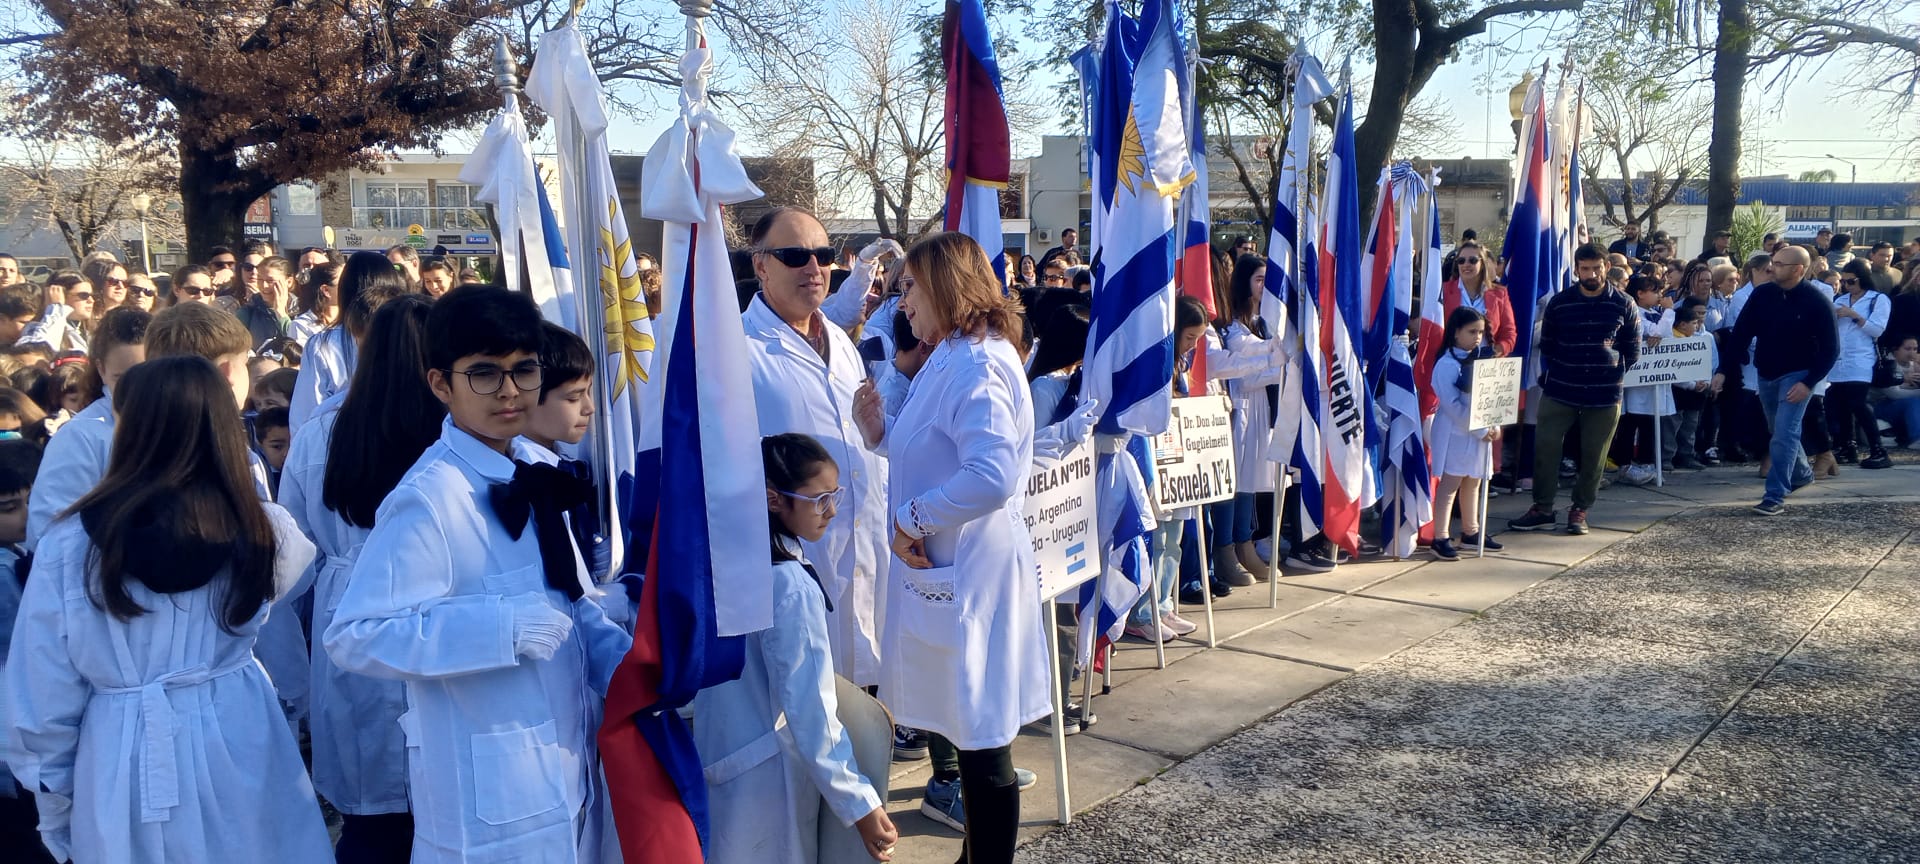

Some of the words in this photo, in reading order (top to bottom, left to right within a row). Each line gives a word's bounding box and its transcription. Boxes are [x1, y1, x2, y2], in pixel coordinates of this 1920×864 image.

[1641, 346, 1653, 356] DE
[1654, 341, 1707, 354] REFERENCIA
[1653, 358, 1670, 369] 103
[1671, 358, 1702, 369] Especial
[1639, 373, 1677, 383] FLORIDA
[1184, 416, 1194, 429] Dr.
[1196, 415, 1210, 428] Don
[1212, 413, 1226, 426] Juan
[1185, 434, 1229, 453] Guglielmetti
[1025, 468, 1058, 498] UELA
[1158, 463, 1211, 504] Escuela
[1039, 496, 1082, 524] Argentina
[1052, 517, 1089, 543] Uruguay
